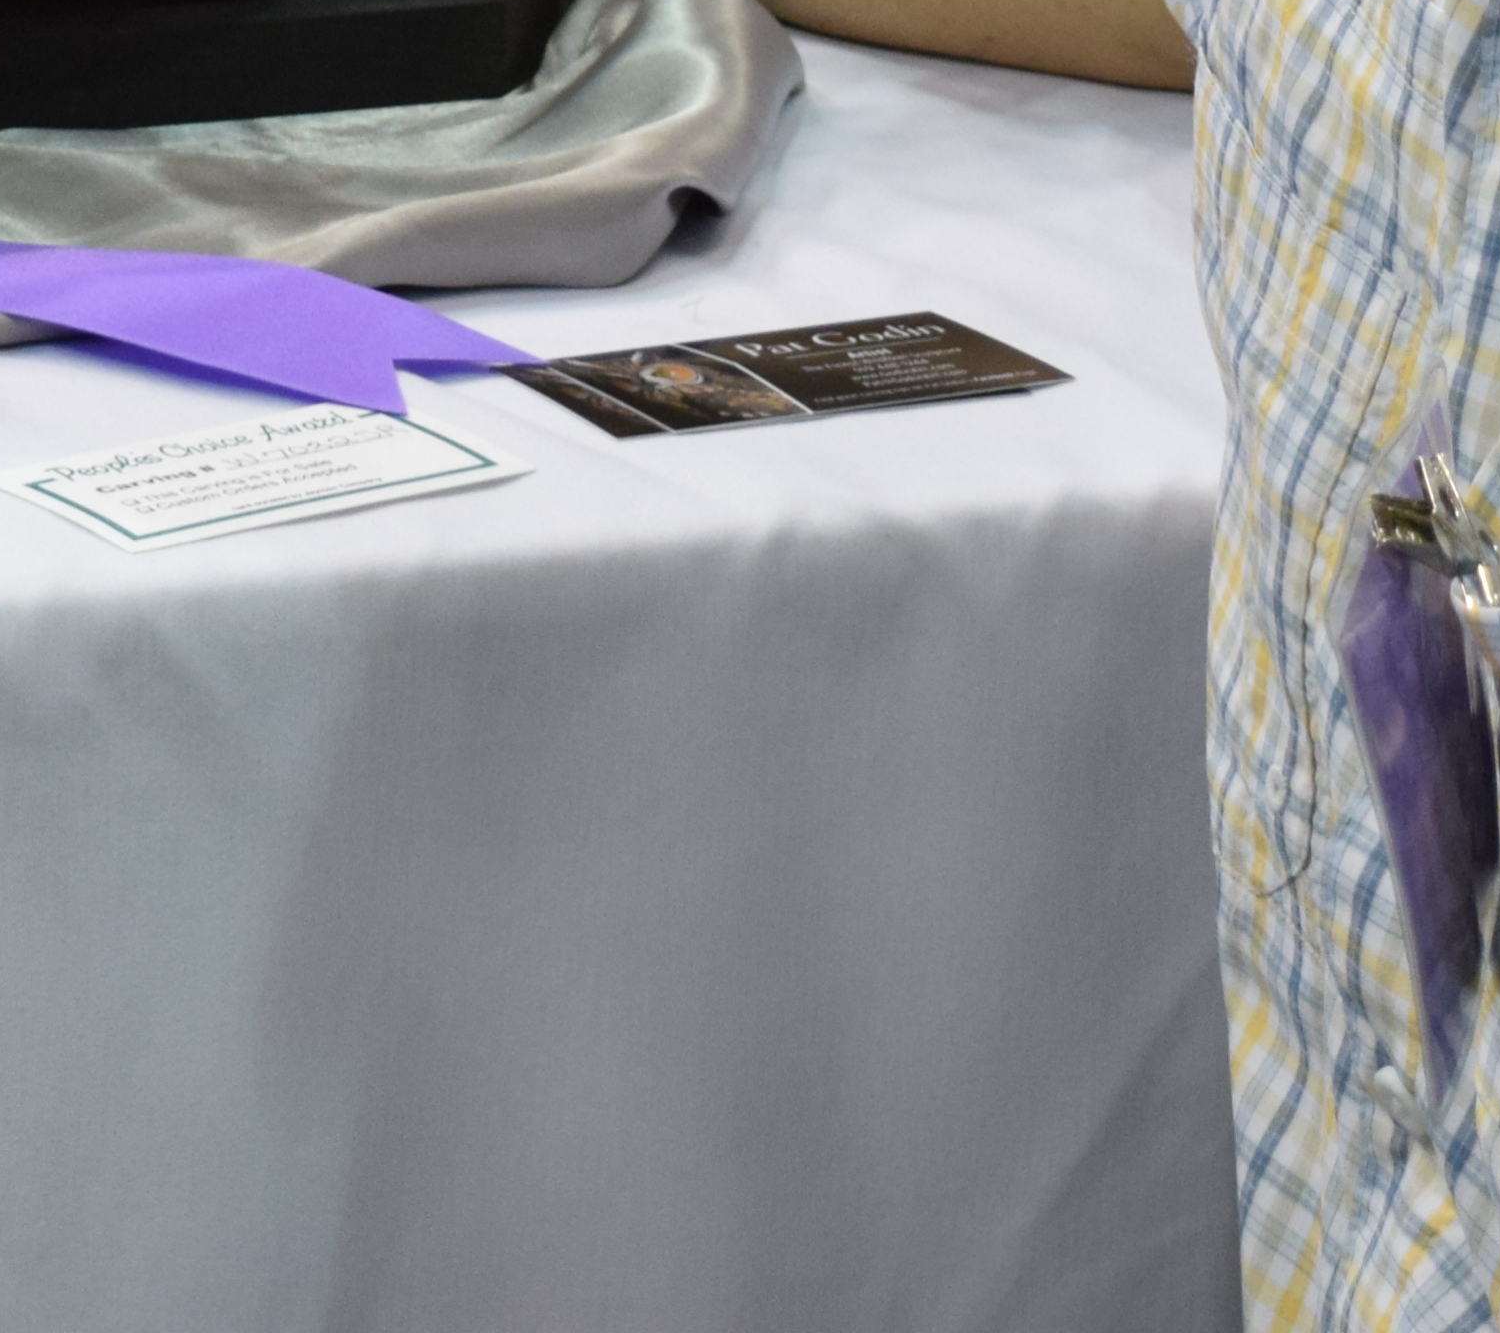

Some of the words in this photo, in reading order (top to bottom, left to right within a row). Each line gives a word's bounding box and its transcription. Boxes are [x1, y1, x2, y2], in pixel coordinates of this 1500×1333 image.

[735, 342, 810, 358] Pat
[812, 324, 945, 347] Godin
[159, 434, 253, 458] Choice
[259, 410, 353, 442] Award
[96, 471, 197, 493] Carving
